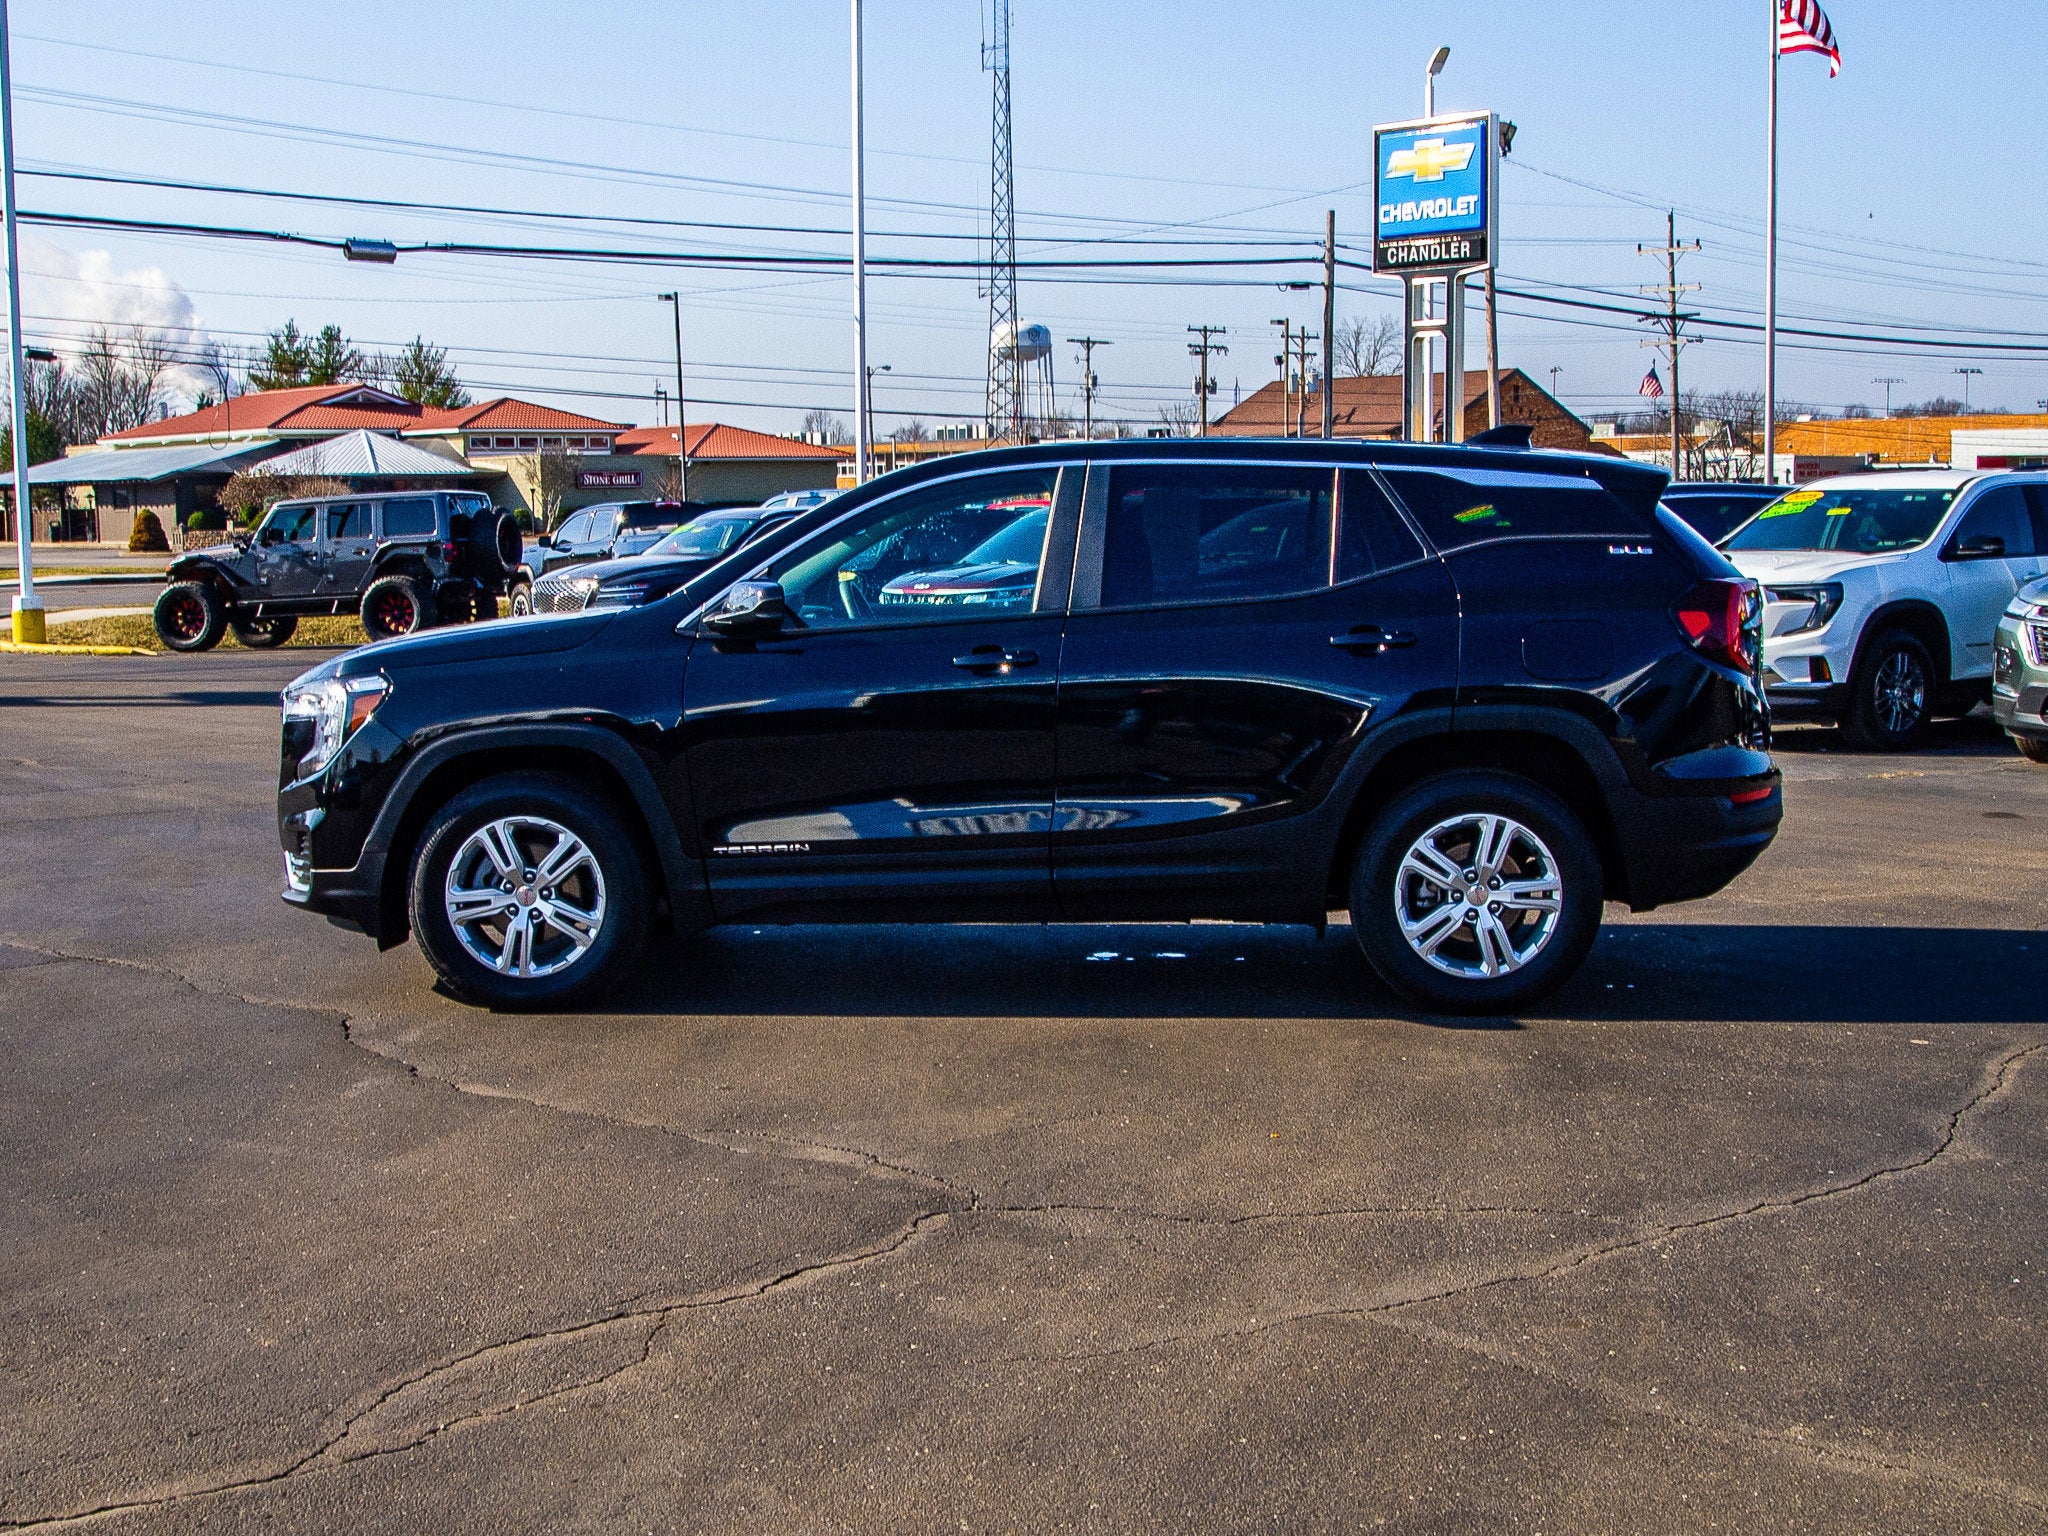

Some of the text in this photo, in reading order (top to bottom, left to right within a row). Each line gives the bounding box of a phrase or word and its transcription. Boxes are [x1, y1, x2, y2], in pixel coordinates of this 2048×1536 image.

[1380, 195, 1479, 224] CHEVROLET
[1387, 241, 1470, 263] CHANDLER
[583, 474, 637, 486] STONE GRILL
